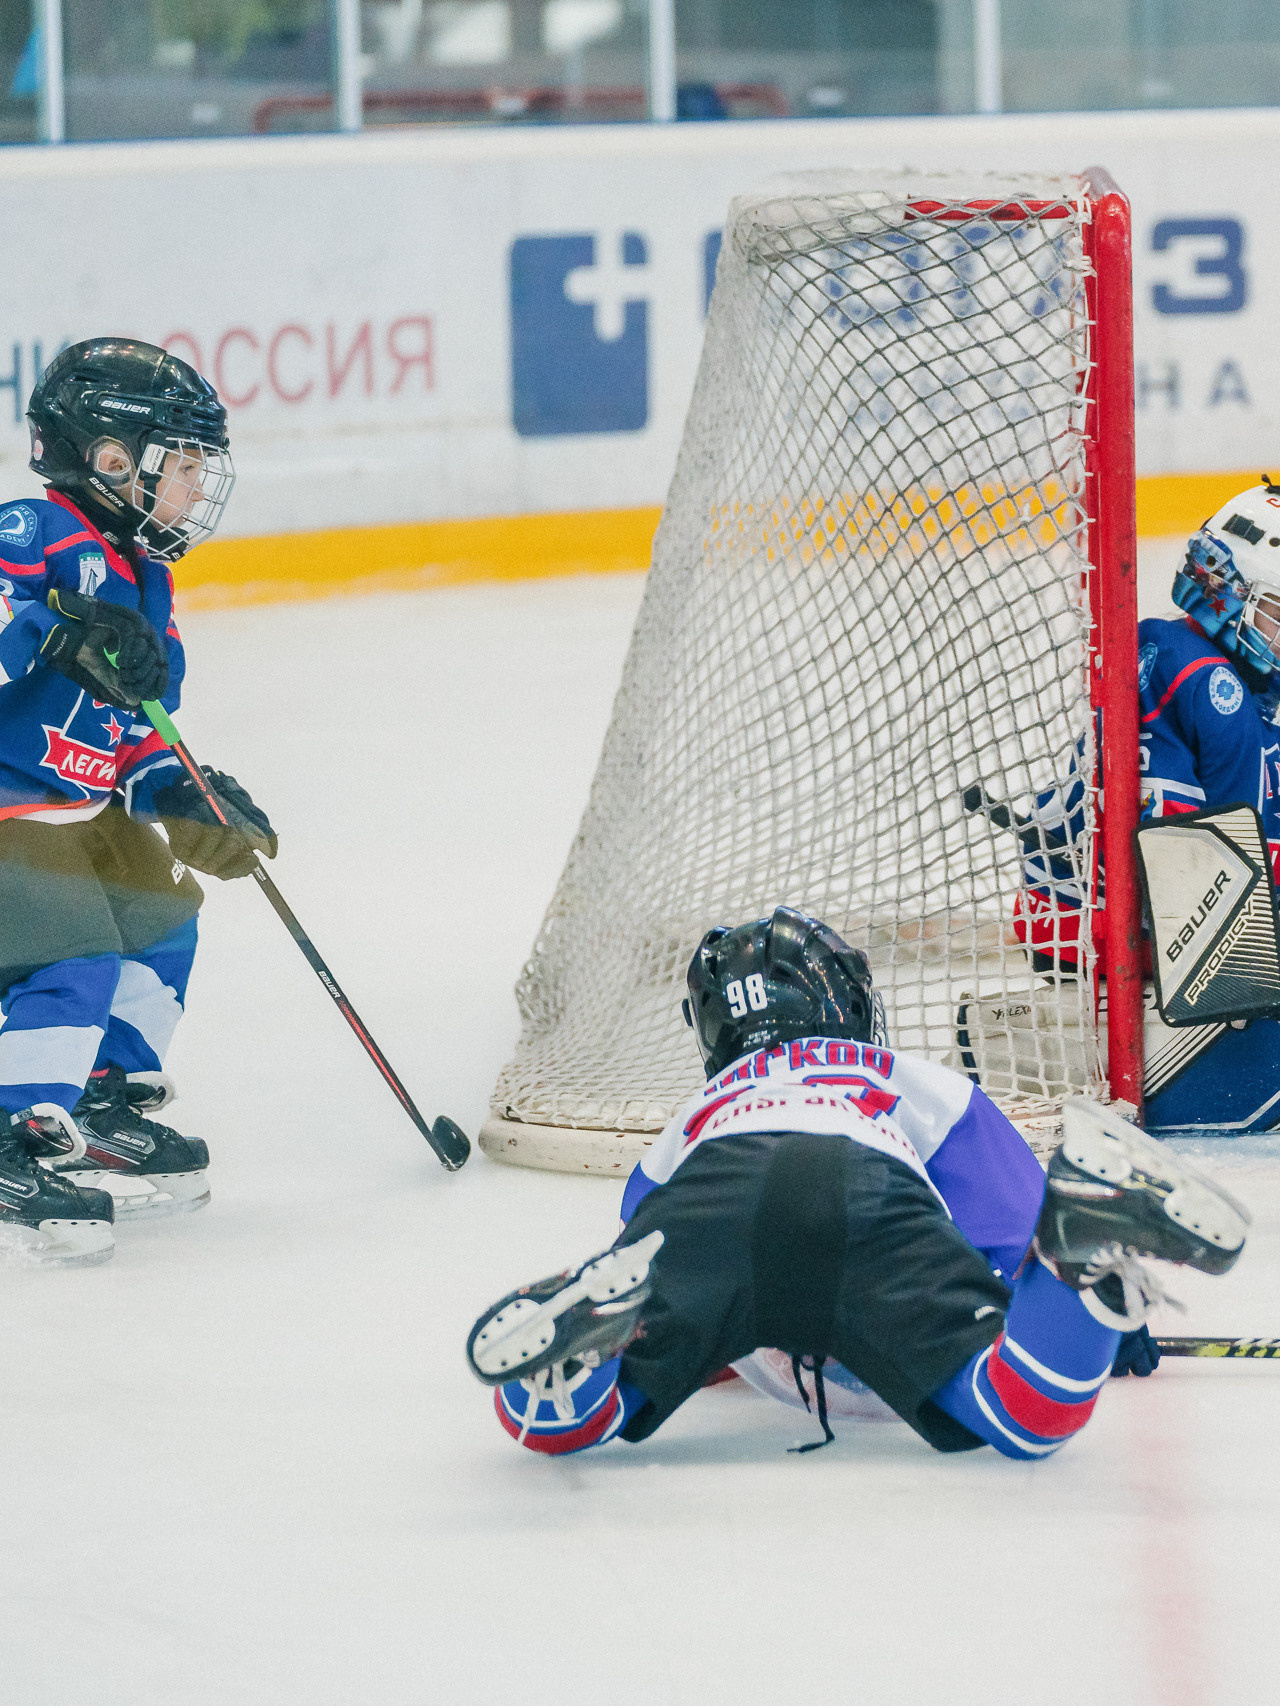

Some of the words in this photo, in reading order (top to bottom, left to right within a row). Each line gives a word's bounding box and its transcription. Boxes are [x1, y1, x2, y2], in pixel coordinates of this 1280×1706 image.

[110, 314, 437, 409] ОССИЯ
[100, 400, 152, 415] BAUER
[88, 477, 125, 508] BAUER
[60, 750, 116, 781] ЛЕГИ
[1165, 869, 1232, 963] BAUER
[1184, 898, 1254, 1006] PRODIGY
[317, 969, 341, 1000] BAUER
[726, 972, 769, 1019] 98
[112, 1131, 147, 1149] BAUER
